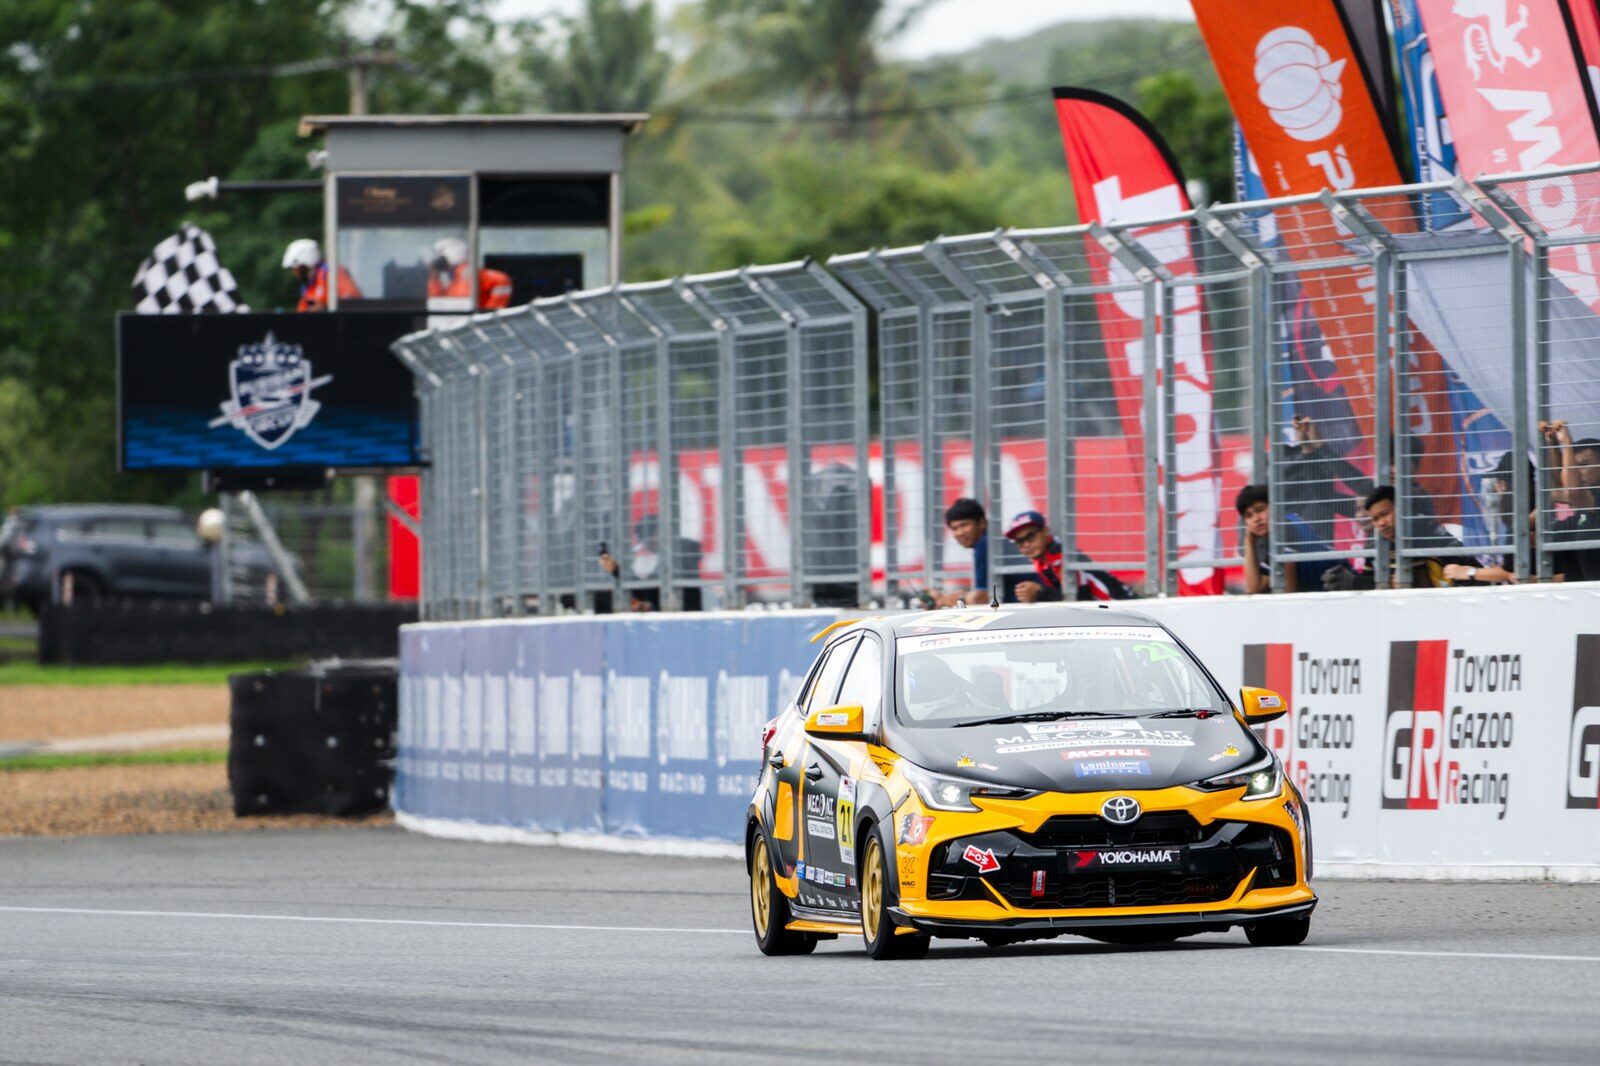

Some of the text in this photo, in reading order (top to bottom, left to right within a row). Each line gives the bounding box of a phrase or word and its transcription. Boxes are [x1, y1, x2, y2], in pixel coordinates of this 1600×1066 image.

[1132, 641, 1181, 663] 21
[1298, 652, 1361, 695] TOYOTA
[1453, 649, 1522, 693] TOYOTA
[1006, 739, 1185, 753] ELECTRICAL CONTRACTORS
[1298, 706, 1354, 749] GAZOO
[1450, 705, 1513, 749] GAZOO
[1066, 748, 1147, 758] MOTUL
[1383, 710, 1444, 799] GR
[1297, 760, 1351, 819] Racing
[1446, 760, 1509, 820] Racing
[840, 804, 852, 844] 21
[968, 850, 989, 865] TOW
[1098, 850, 1172, 864] YOKOHAMA
